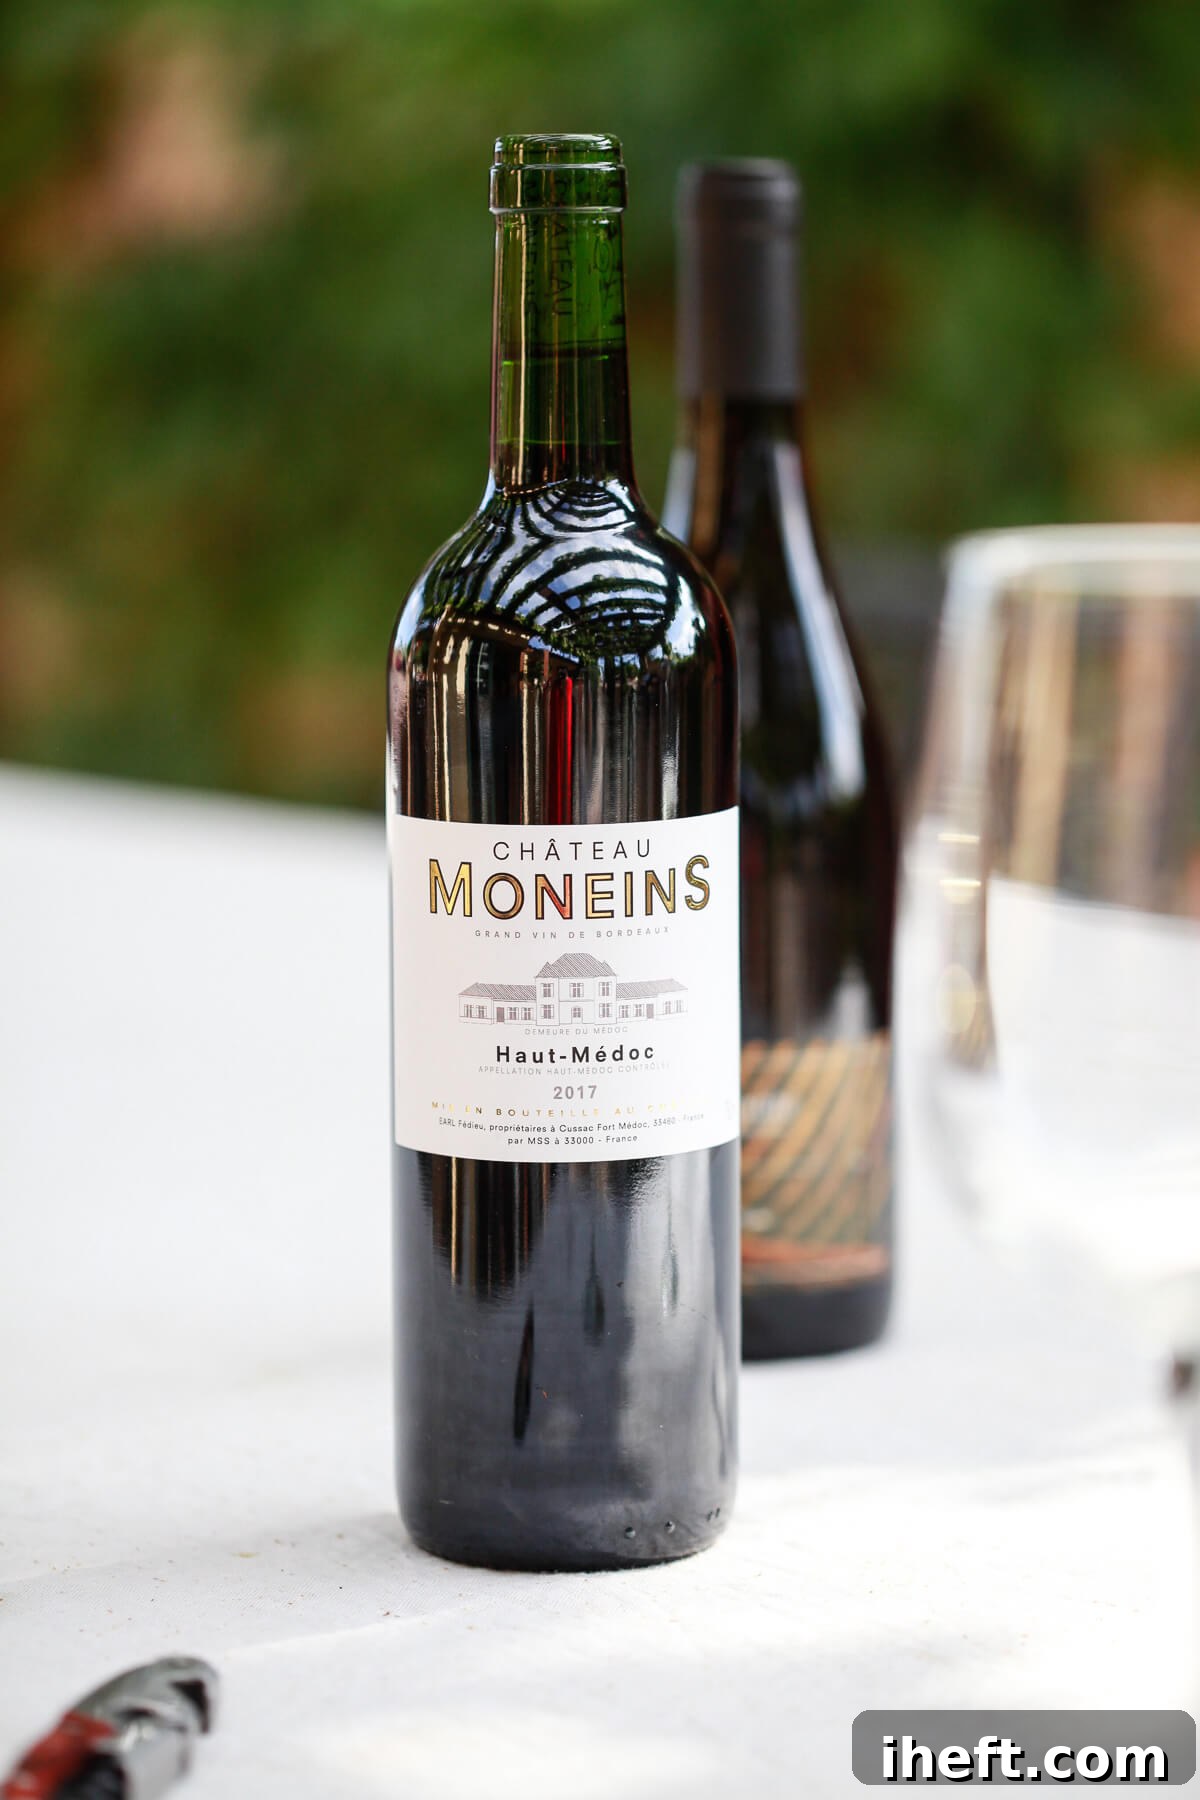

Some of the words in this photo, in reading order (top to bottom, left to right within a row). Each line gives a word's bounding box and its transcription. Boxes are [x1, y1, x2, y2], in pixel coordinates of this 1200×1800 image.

[492, 837, 651, 861] CHÂTEAU
[428, 854, 711, 921] MONEINS
[474, 929, 522, 940] GRAND
[532, 930, 557, 940] VIN
[567, 930, 586, 940] DE
[595, 926, 670, 939] BORDEAUX
[524, 1027, 571, 1037] DEMEURE
[575, 1027, 589, 1036] DU
[593, 1025, 629, 1036] MÉDOC
[495, 1044, 655, 1064] Haut-Médoc
[477, 1065, 542, 1077] APPELLATION
[552, 1084, 598, 1100] 2017
[495, 1107, 600, 1118] BOUTEILLE
[614, 1106, 635, 1117] AU
[438, 1116, 456, 1128] EARL
[489, 1122, 547, 1134] propriétaires
[550, 1124, 556, 1133] à
[559, 1123, 594, 1133] Cussac
[597, 1122, 616, 1132] Fort
[618, 1119, 651, 1131] Médoc,
[507, 1138, 524, 1147] par
[527, 1136, 551, 1146] MSS
[554, 1136, 560, 1146] à
[564, 1136, 595, 1146] 33000
[605, 1133, 639, 1144] France
